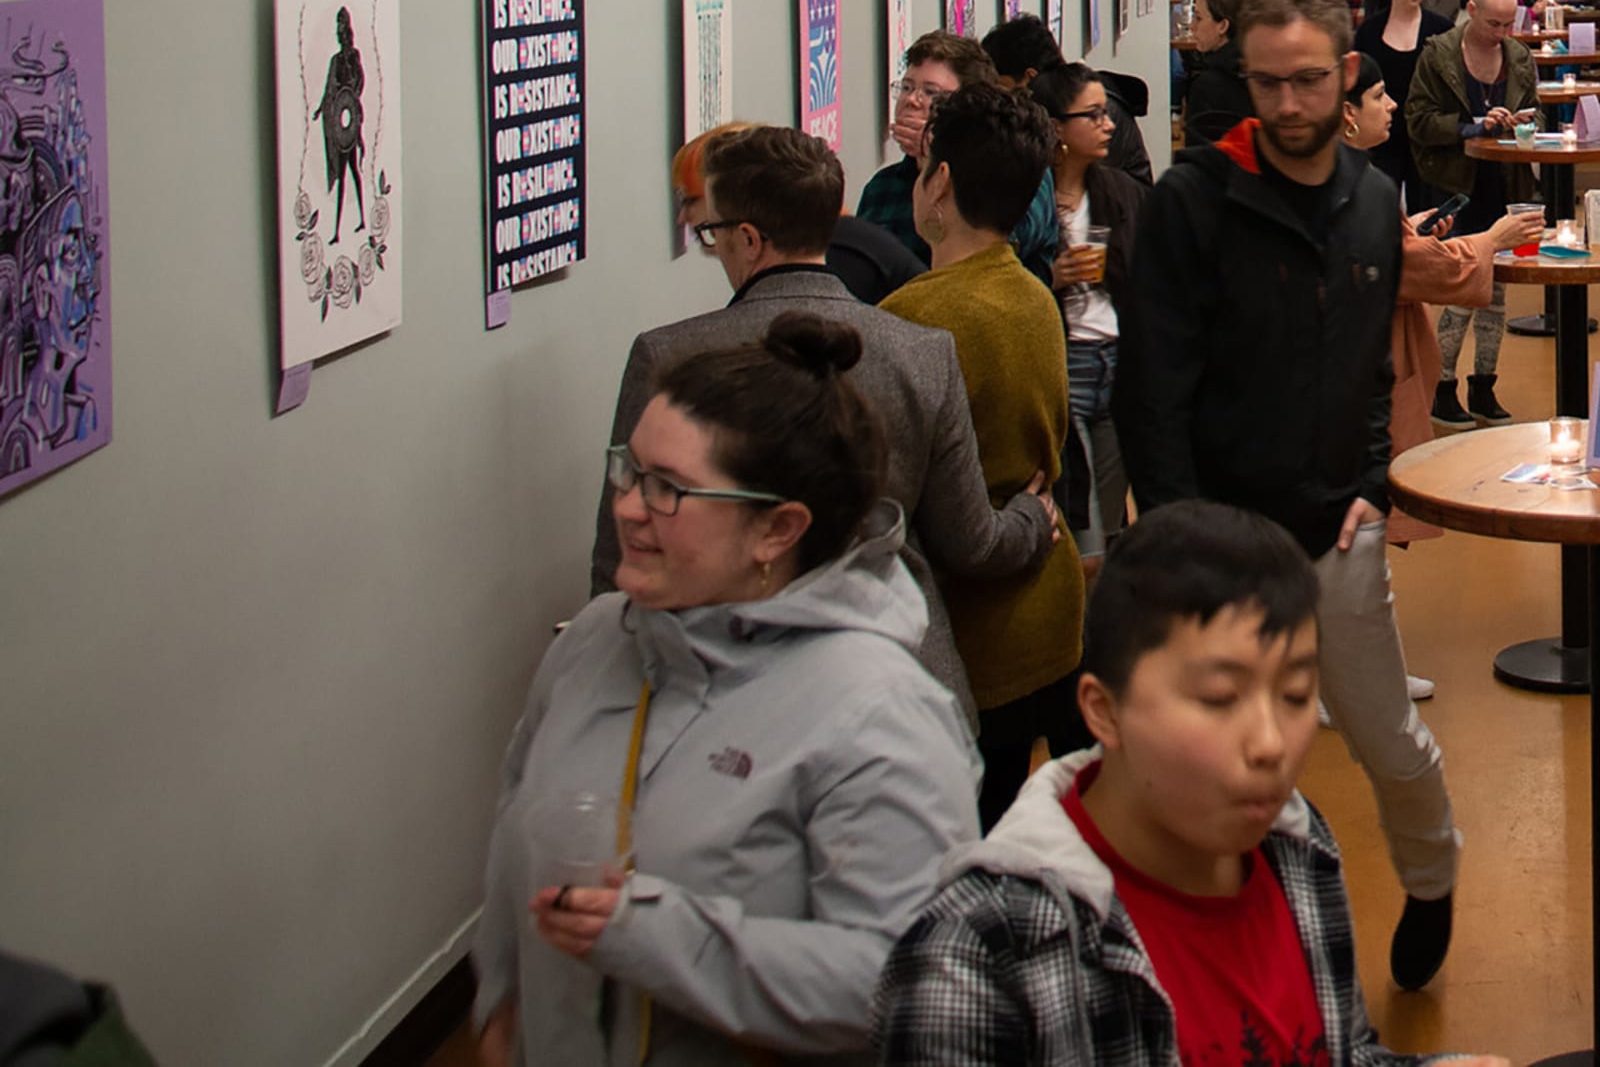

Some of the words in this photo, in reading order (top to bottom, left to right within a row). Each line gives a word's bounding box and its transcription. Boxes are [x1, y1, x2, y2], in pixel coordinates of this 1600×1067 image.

[492, 38, 519, 75] OUR
[519, 30, 578, 69] EXISTENCE
[494, 83, 508, 119] IS
[496, 127, 521, 164] OUR
[522, 114, 580, 157] EXISTENCE
[497, 173, 511, 209] IS
[496, 215, 521, 254] OUR
[522, 197, 580, 245] EXISTENCE
[497, 263, 511, 290] IS
